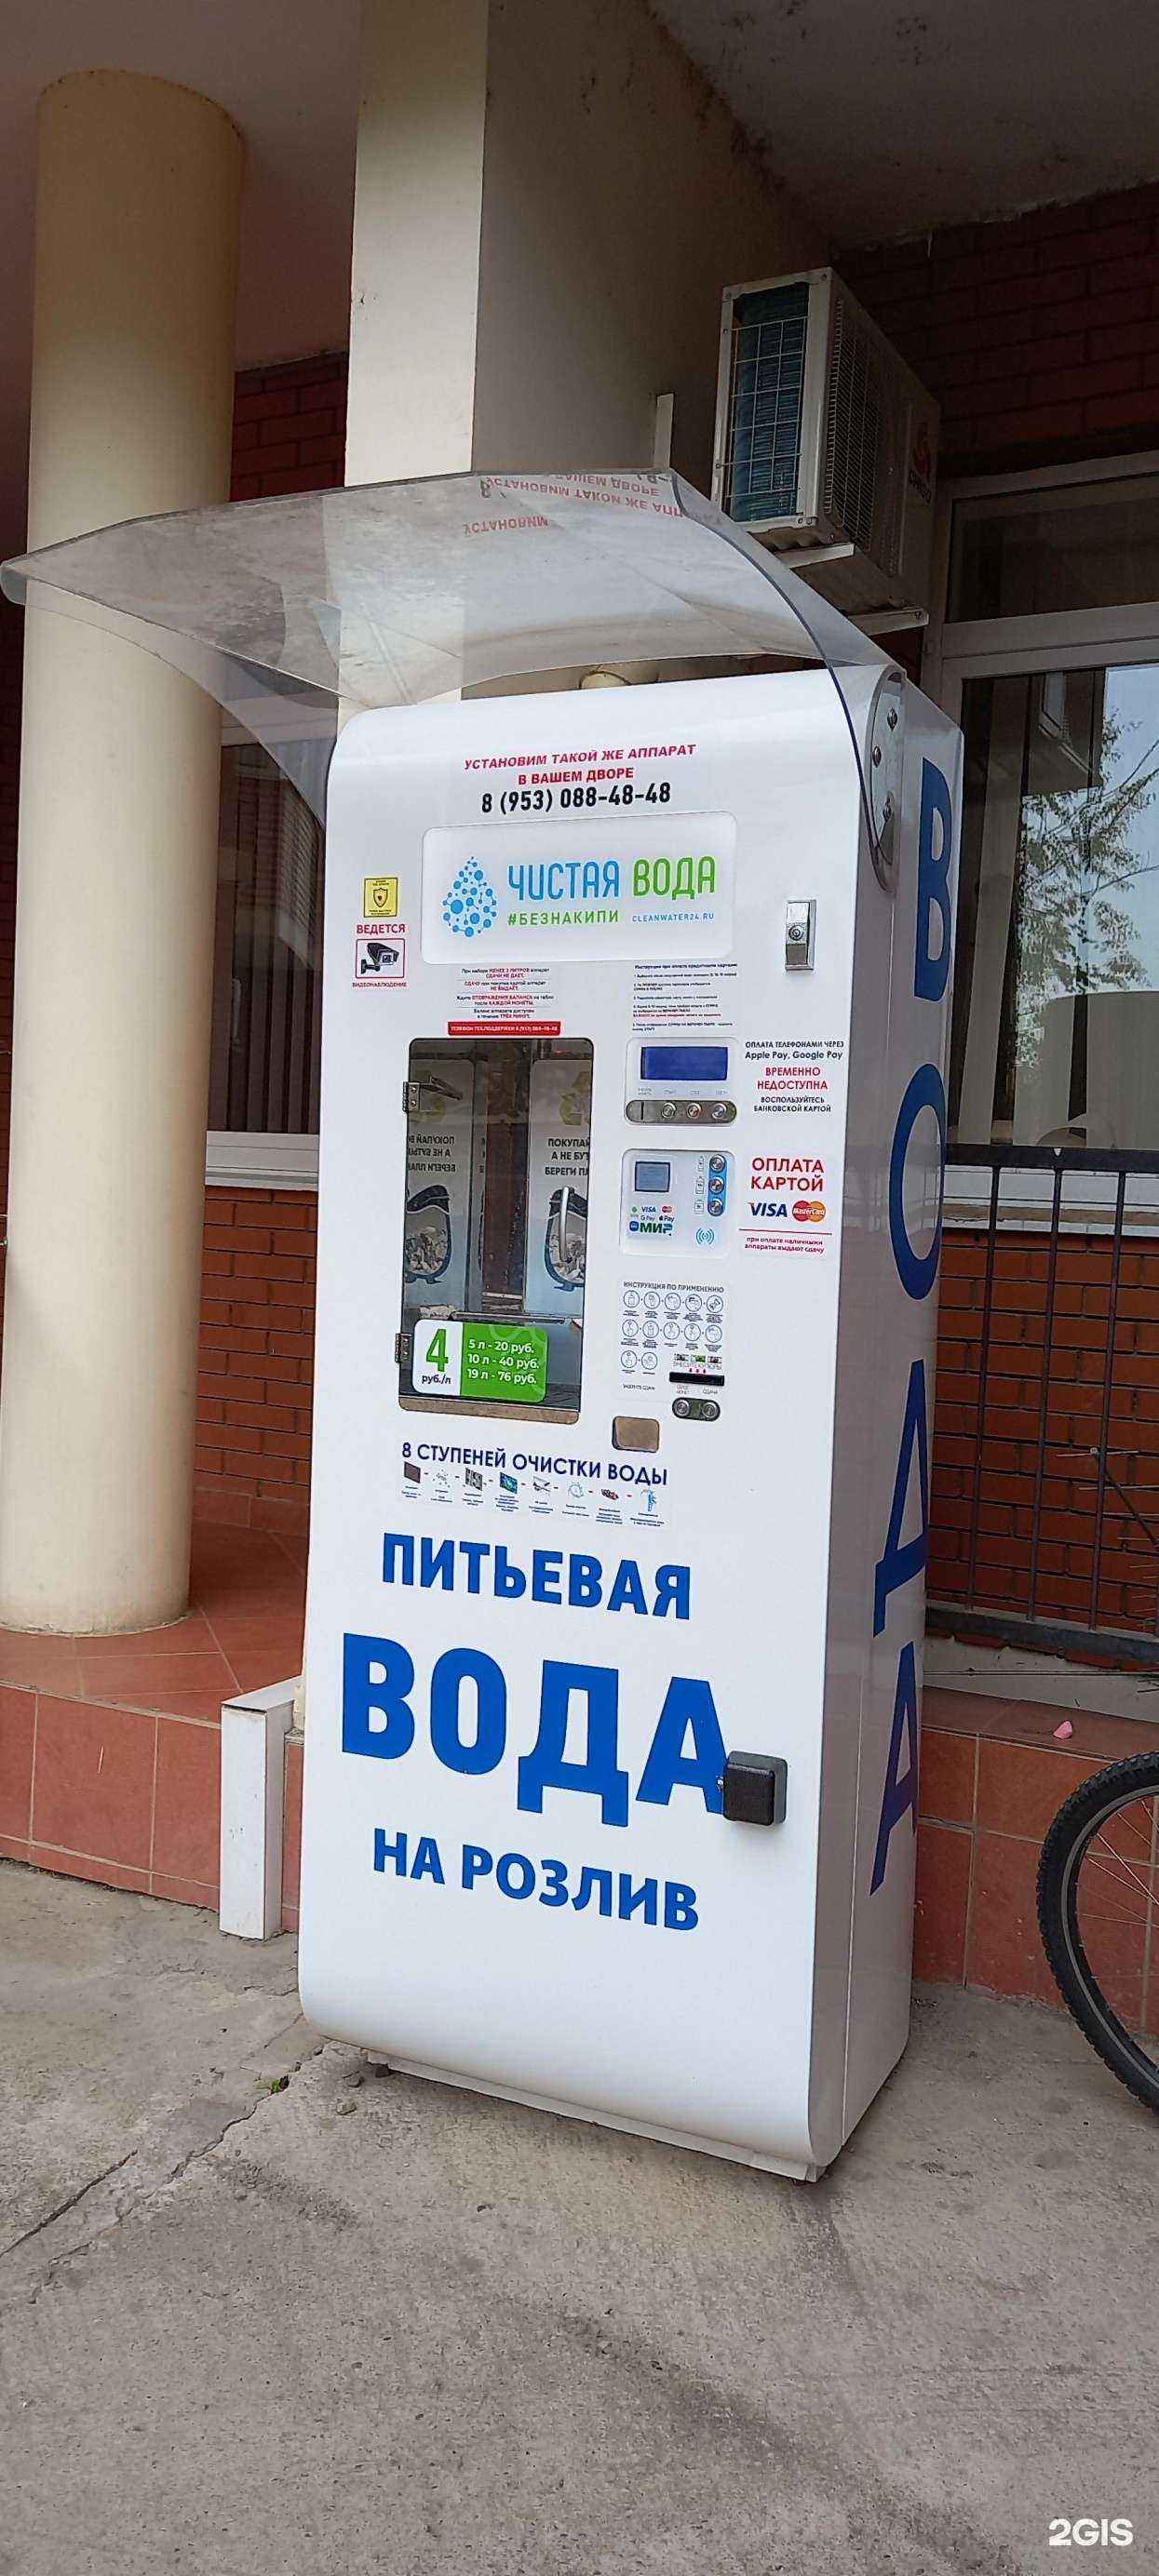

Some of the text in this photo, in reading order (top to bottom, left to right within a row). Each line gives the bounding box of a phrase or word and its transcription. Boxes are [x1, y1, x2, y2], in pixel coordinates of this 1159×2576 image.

[464, 745, 696, 771] УСТАНОВИМ ТАКОЙ ЖЕ АППАРАТ
[519, 768, 634, 785] В ВАШЕМ ДВОРЕ
[482, 782, 671, 814] 8 (953) 088-48-48
[507, 856, 716, 901] ЧИСТАЯ ВОДА
[507, 910, 619, 927] #БЕЗНАКИПИ
[632, 913, 714, 922] CLEANWATER24.RU
[357, 924, 406, 934] ВЕДЕТСЯ
[745, 1051, 843, 1060] Apple Pay, Google Pay
[765, 1067, 821, 1077] ВРЕМЕННО
[757, 1080, 829, 1091] НЕДОСТУПНА
[761, 1095, 825, 1104] ВОСПОЛЬЗУЙТЕСЬ
[803, 1105, 831, 1113] КАРТОЙ
[551, 1151, 558, 1160] А
[560, 1151, 572, 1160] НЕ
[545, 1167, 577, 1175] БЕРЕГИ
[752, 1158, 825, 1173] ОПЛАТА
[750, 1174, 823, 1191] КАРТОЙ
[748, 1201, 788, 1217] VISA
[640, 1222, 673, 1234] МИР
[623, 1281, 666, 1291] ИНСТРУКЦИЯ
[678, 1283, 724, 1293] ПРИМЕНЕНИЮ
[869, 758, 951, 1896] ВОДА
[425, 1328, 449, 1373] 4
[468, 1339, 476, 1348] 5
[494, 1341, 508, 1350] 20
[511, 1342, 534, 1355] руб.
[467, 1353, 479, 1364] 10
[481, 1356, 491, 1364] л
[499, 1357, 514, 1366] 40
[517, 1358, 540, 1370] руб.
[422, 1374, 451, 1384] руб./л
[467, 1369, 479, 1379] 19
[479, 1372, 489, 1380] л
[497, 1372, 511, 1381] 76
[514, 1373, 537, 1385] руб.
[402, 1442, 668, 1486] 8 СТУПЕНЕЙ ОЧИСТКИ ВОДЫ
[382, 1532, 691, 1620] ПИТЬЕВАЯ
[342, 1632, 729, 1829] ВОДА
[373, 1828, 700, 1932] НА РОЗЛИВ
